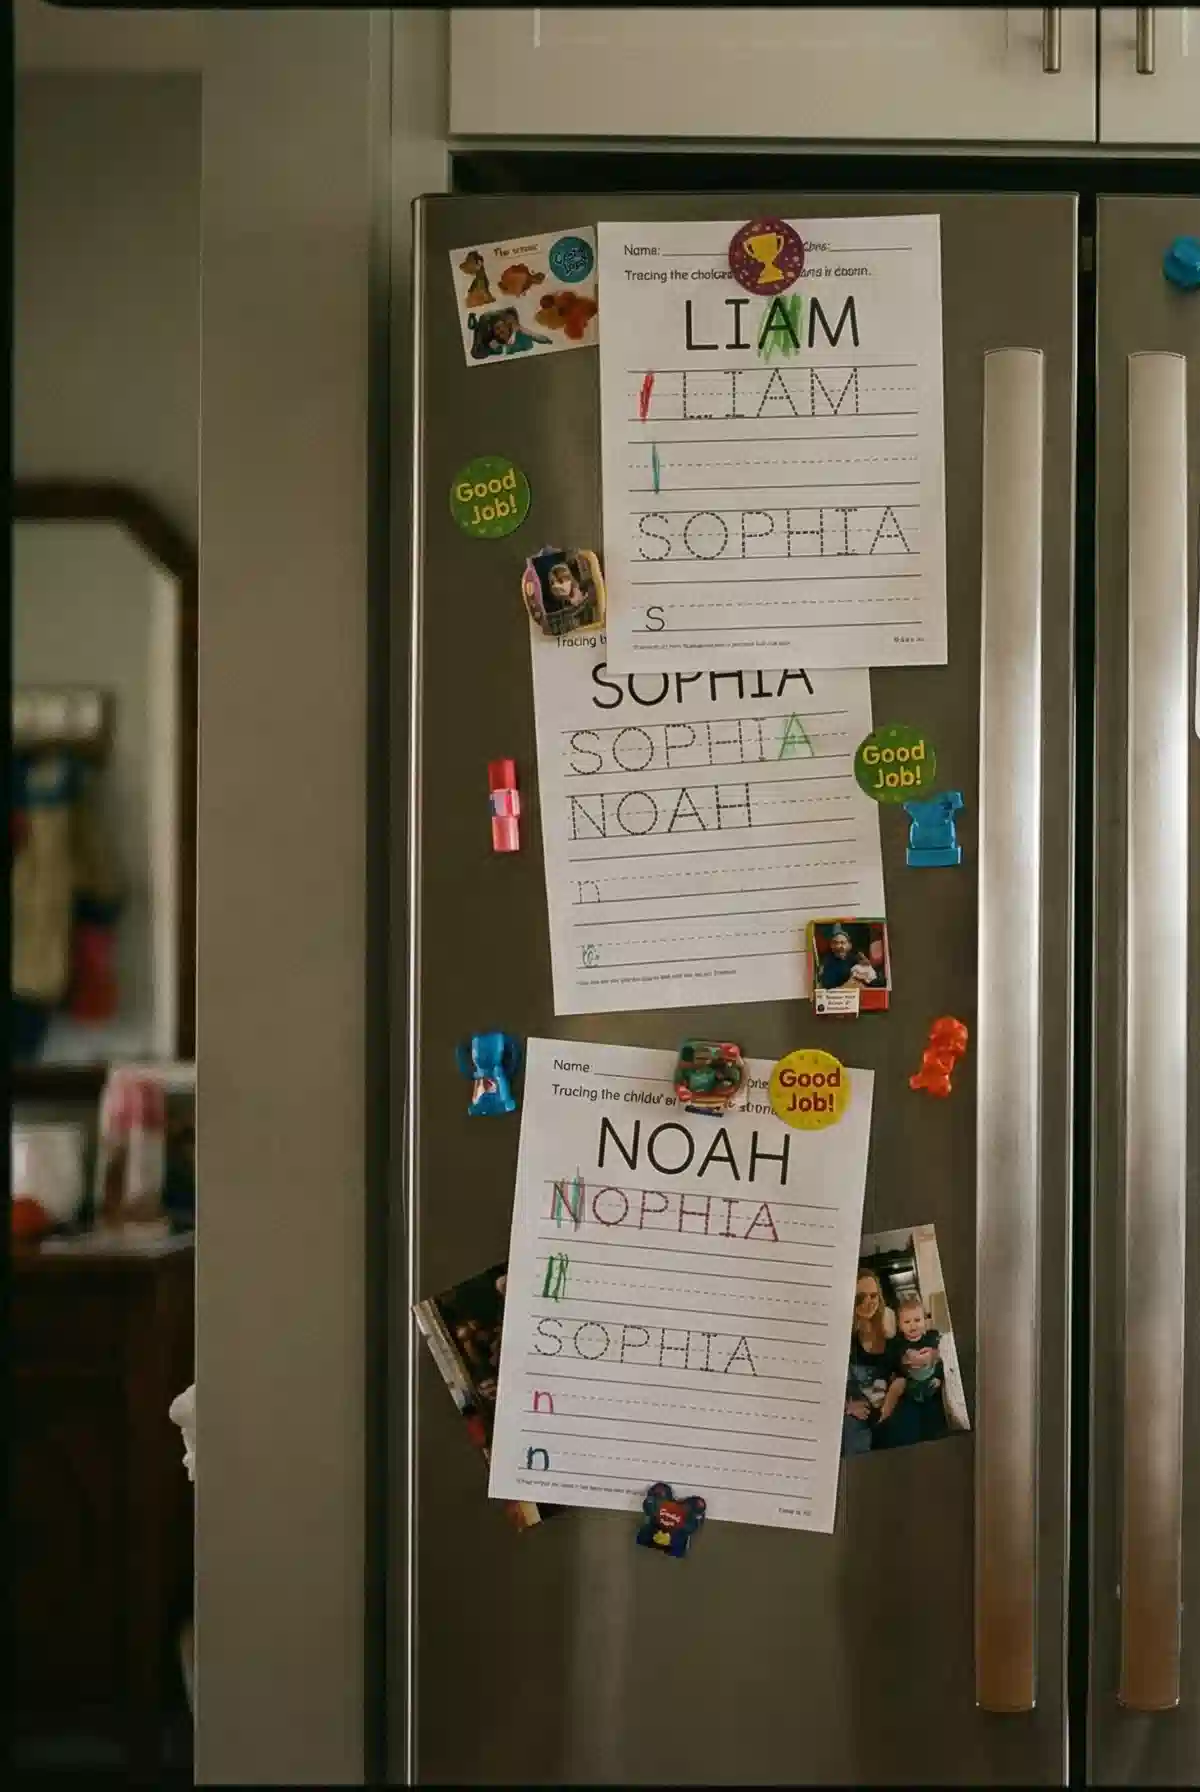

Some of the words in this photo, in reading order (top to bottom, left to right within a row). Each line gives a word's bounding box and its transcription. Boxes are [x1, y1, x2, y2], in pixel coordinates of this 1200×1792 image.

[624, 244, 661, 256] Name:
[669, 270, 689, 281] the
[684, 296, 860, 350] LIAM
[682, 368, 861, 419] LIAM
[455, 469, 517, 502] Good
[471, 496, 518, 526] Job!
[638, 506, 911, 560] SOPHIA
[569, 711, 815, 775] SOPHIA
[862, 741, 926, 765] Good
[873, 764, 923, 789] Job!
[569, 783, 752, 838] NOAH
[779, 1067, 842, 1088] Good
[601, 1088, 621, 1101] the
[786, 1091, 835, 1113] Job!
[597, 1116, 791, 1186] NOAH
[534, 1316, 758, 1377] SOPHIA
[531, 1387, 555, 1414] n
[526, 1443, 550, 1472] n
